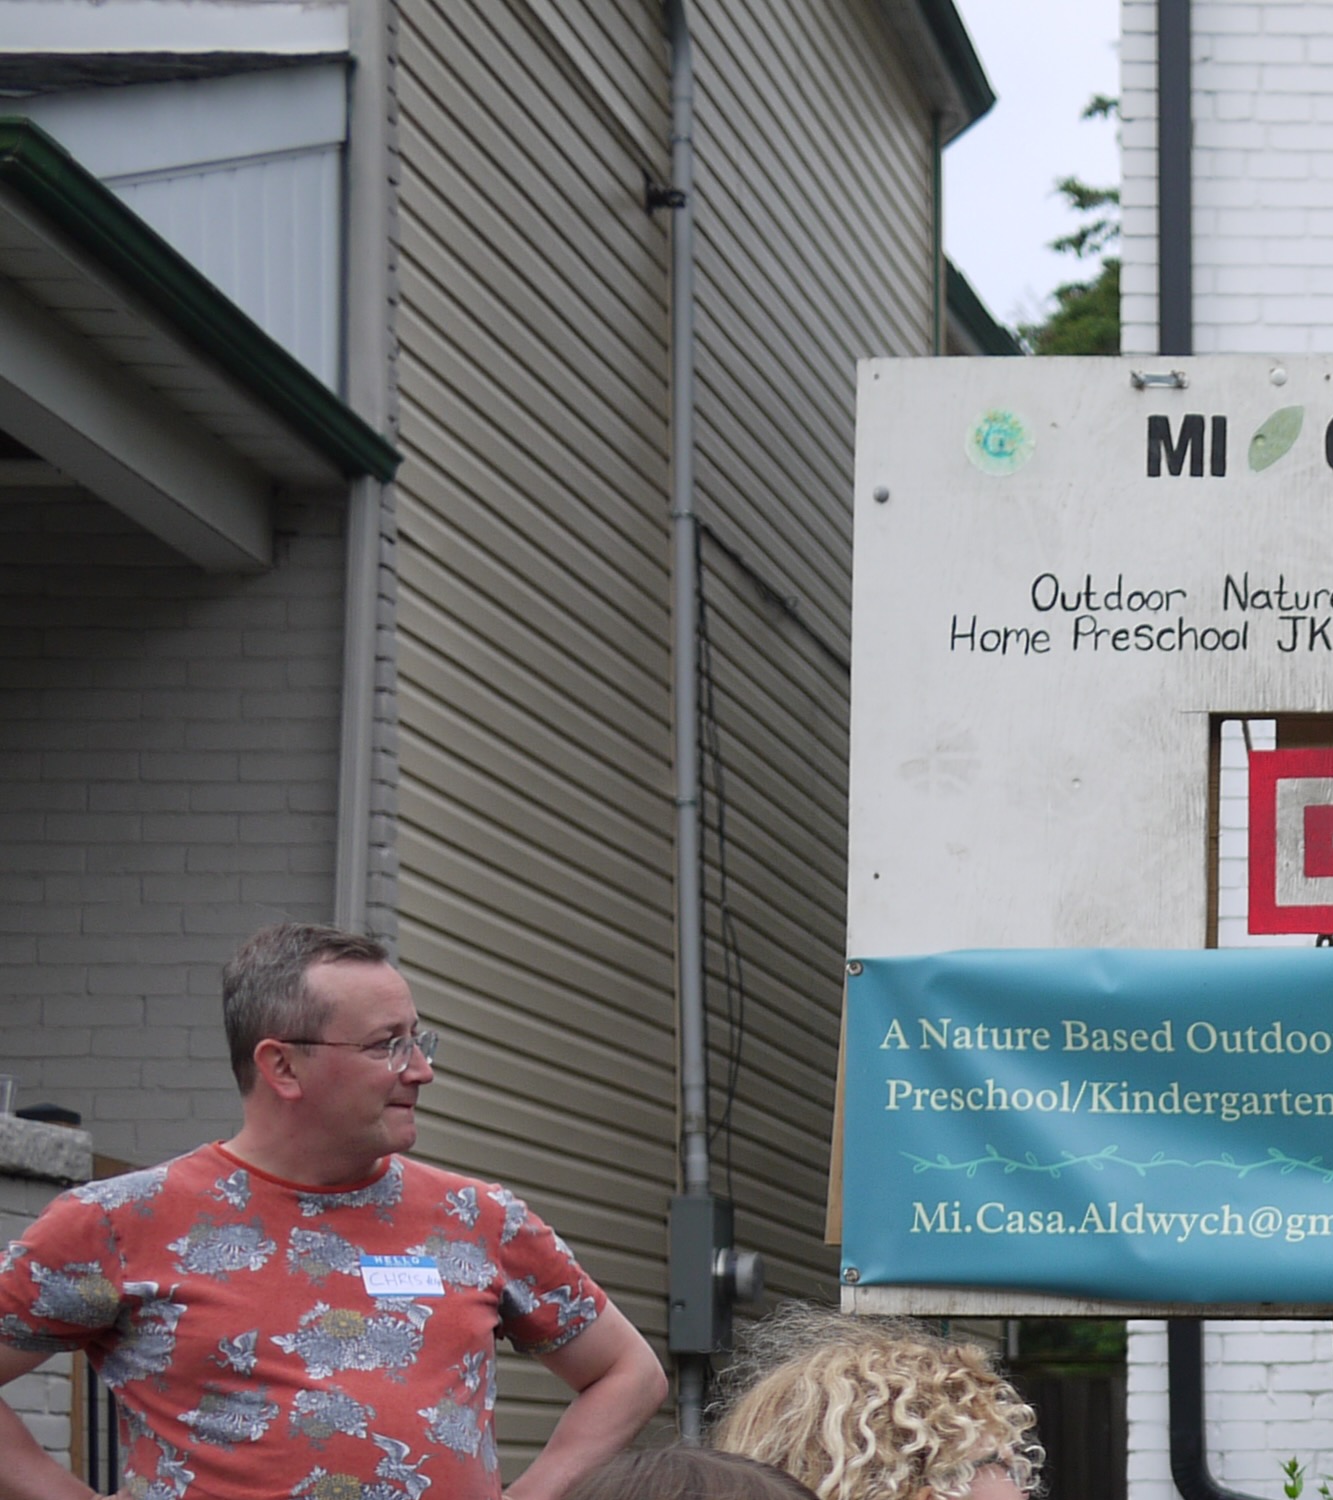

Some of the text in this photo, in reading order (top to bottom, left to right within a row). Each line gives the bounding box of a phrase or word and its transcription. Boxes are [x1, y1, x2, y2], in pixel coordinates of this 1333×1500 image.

[1147, 415, 1227, 477] MI
[1031, 573, 1187, 614] Outdoor
[950, 620, 1052, 655] Home
[1073, 617, 1249, 653] Preschool
[880, 1018, 910, 1050] A
[918, 1019, 1050, 1051] Nature
[1061, 1020, 1175, 1053] Based
[374, 1255, 420, 1265] HELLO
[369, 1272, 423, 1287] CHRIS
